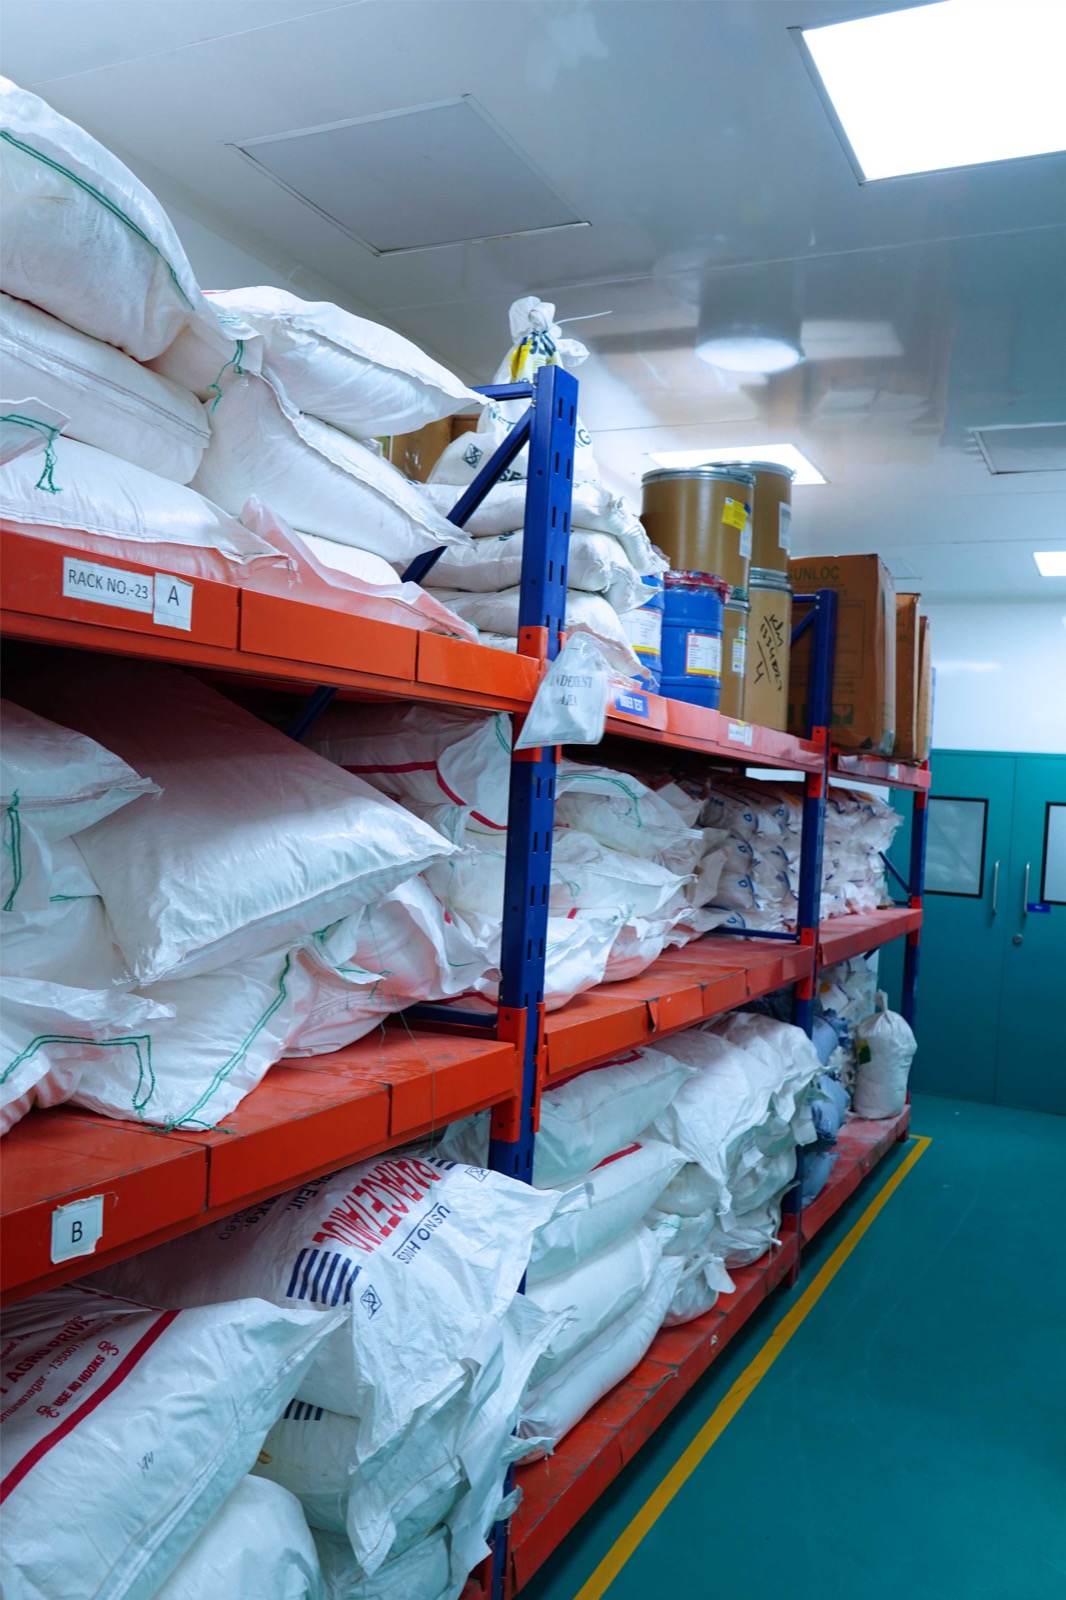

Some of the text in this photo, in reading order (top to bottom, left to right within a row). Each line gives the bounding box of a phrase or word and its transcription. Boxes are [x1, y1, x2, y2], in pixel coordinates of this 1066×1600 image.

[68, 569, 149, 600] RACK NO.-23
[167, 585, 180, 606] A
[71, 1220, 83, 1244] B
[7, 1347, 51, 1383] AGRO
[53, 1354, 106, 1407] USE NO HOOKS
